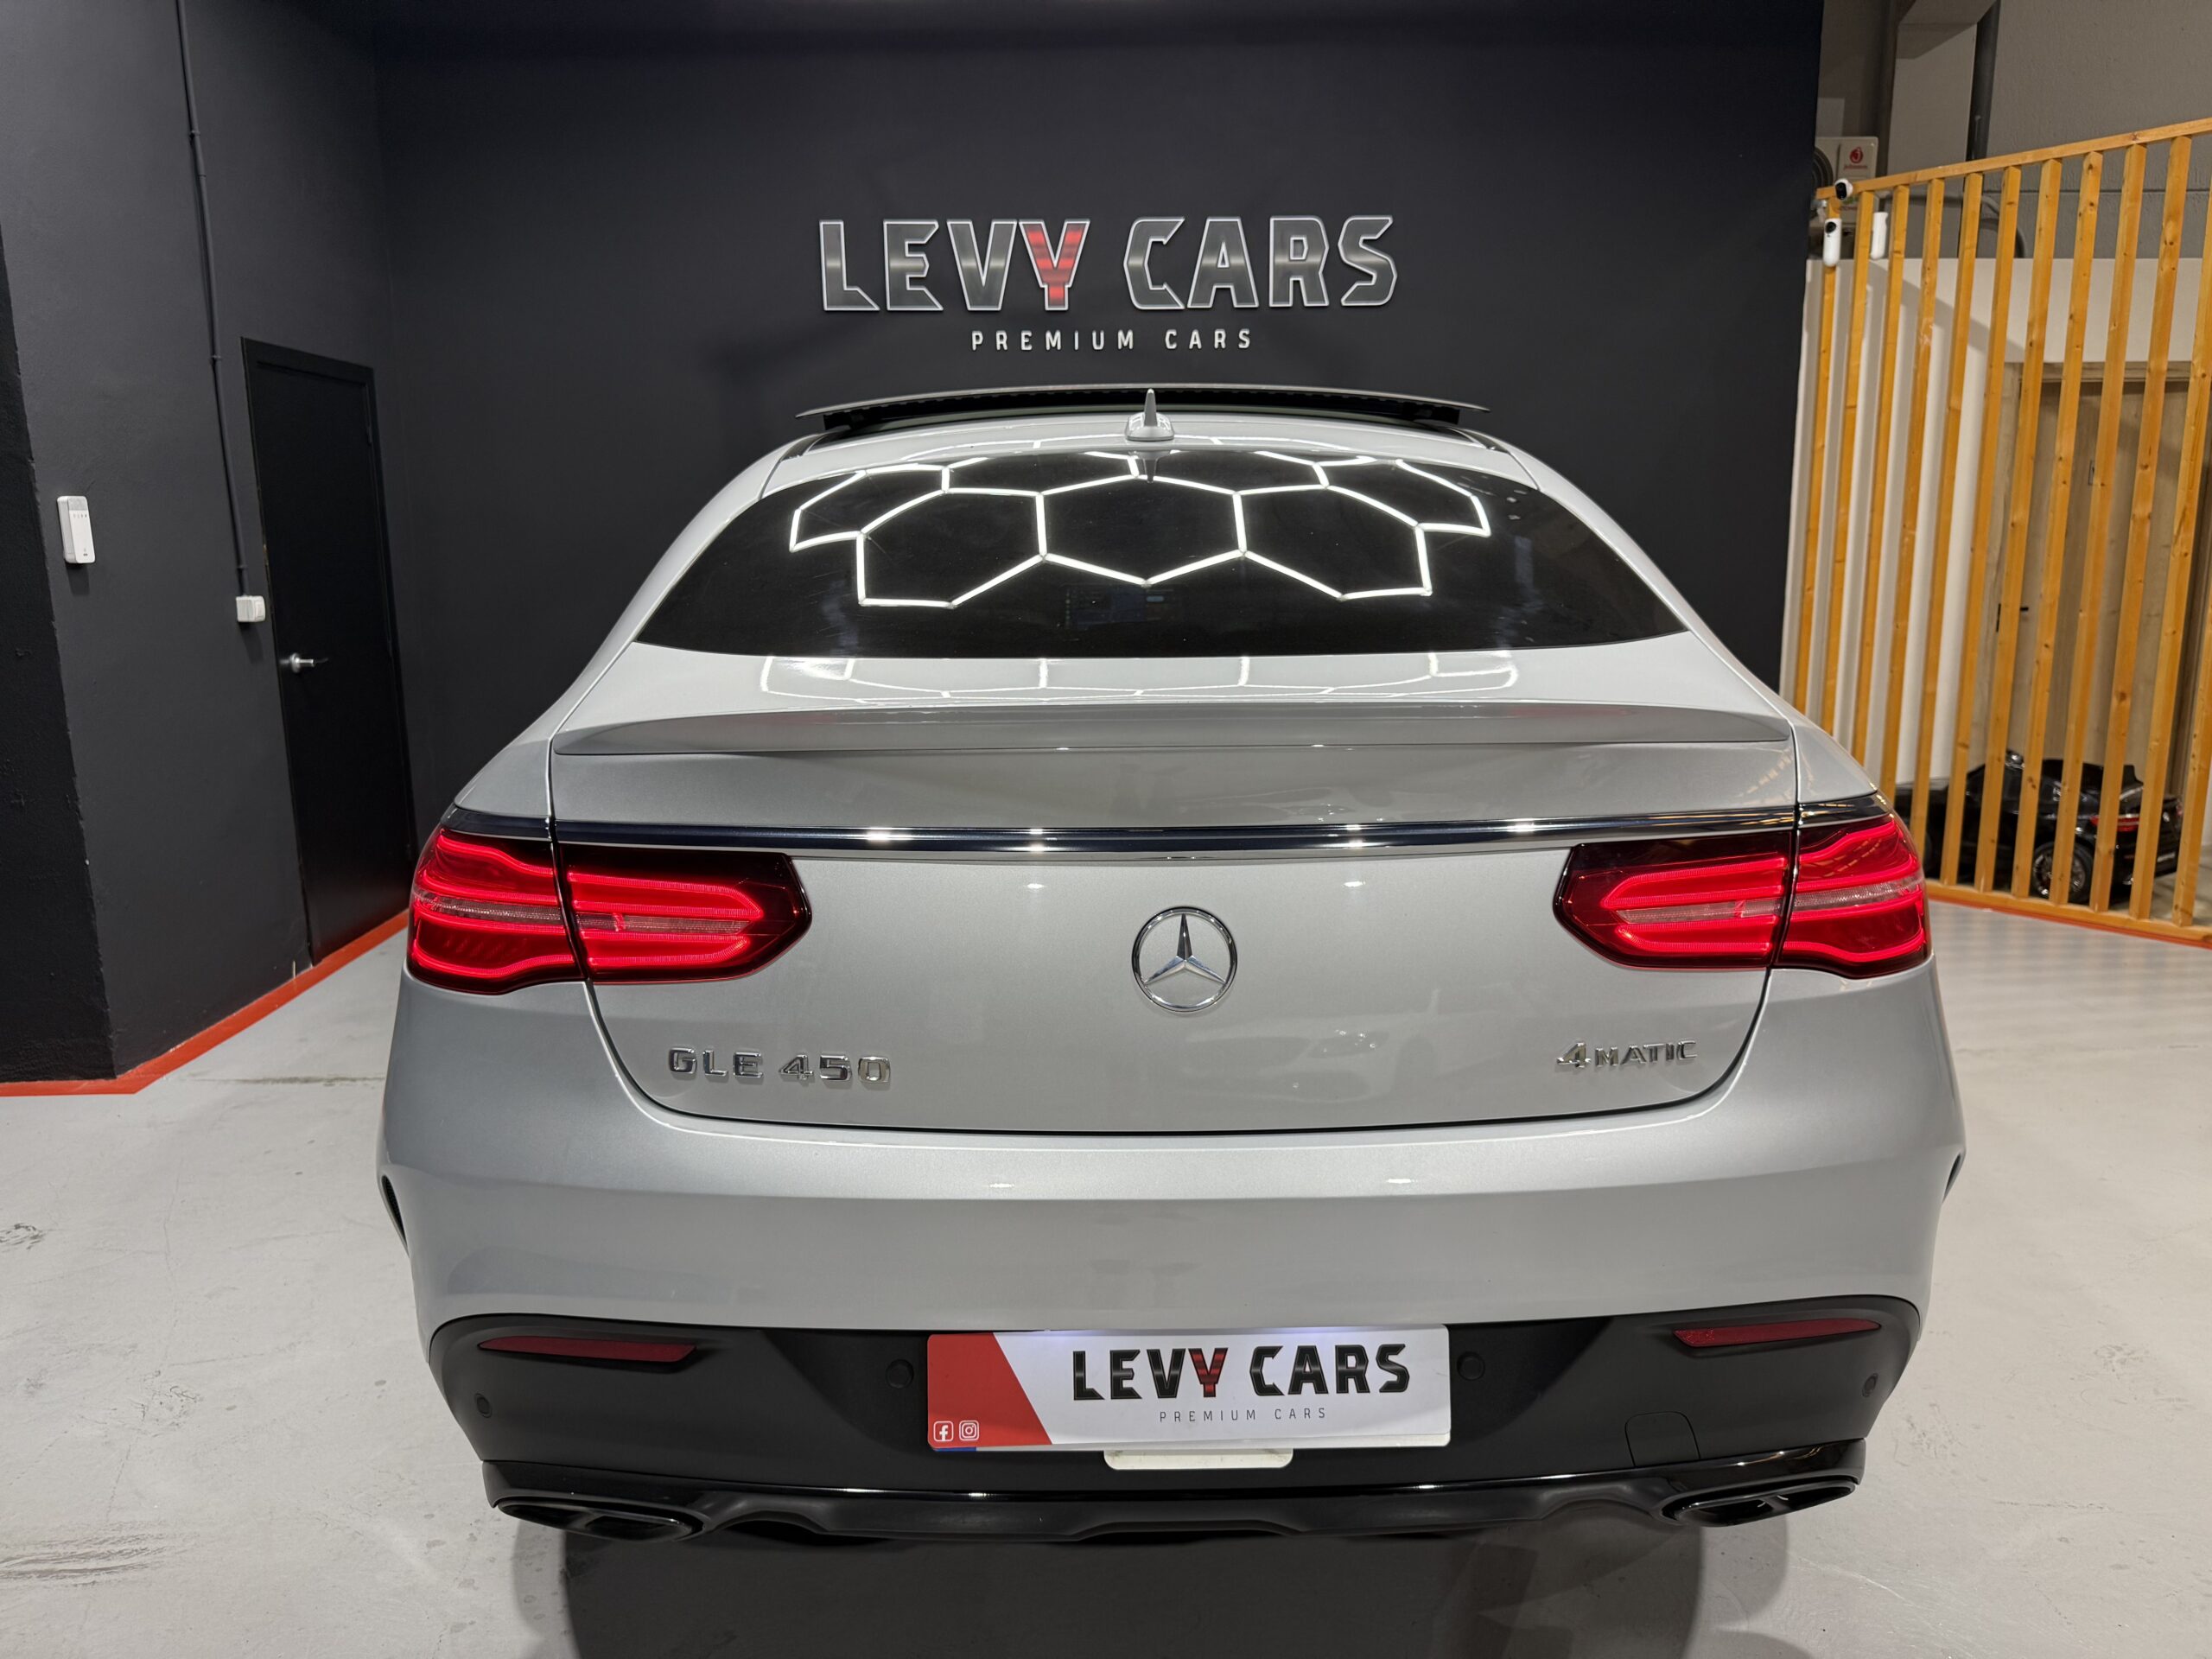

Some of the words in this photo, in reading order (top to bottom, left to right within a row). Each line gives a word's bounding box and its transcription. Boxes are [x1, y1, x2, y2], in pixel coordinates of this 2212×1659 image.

[819, 219, 1090, 312] LEVY
[1123, 214, 1398, 309] CARS
[971, 329, 1134, 351] PREMIUM
[1165, 328, 1251, 349] CARS
[669, 1047, 764, 1078] GLE
[779, 1054, 892, 1083] 450
[1072, 1347, 1229, 1401] LEVY
[1249, 1343, 1410, 1397] CARS
[1159, 1408, 1256, 1422] PREMIUM
[1274, 1407, 1326, 1420] CARS
